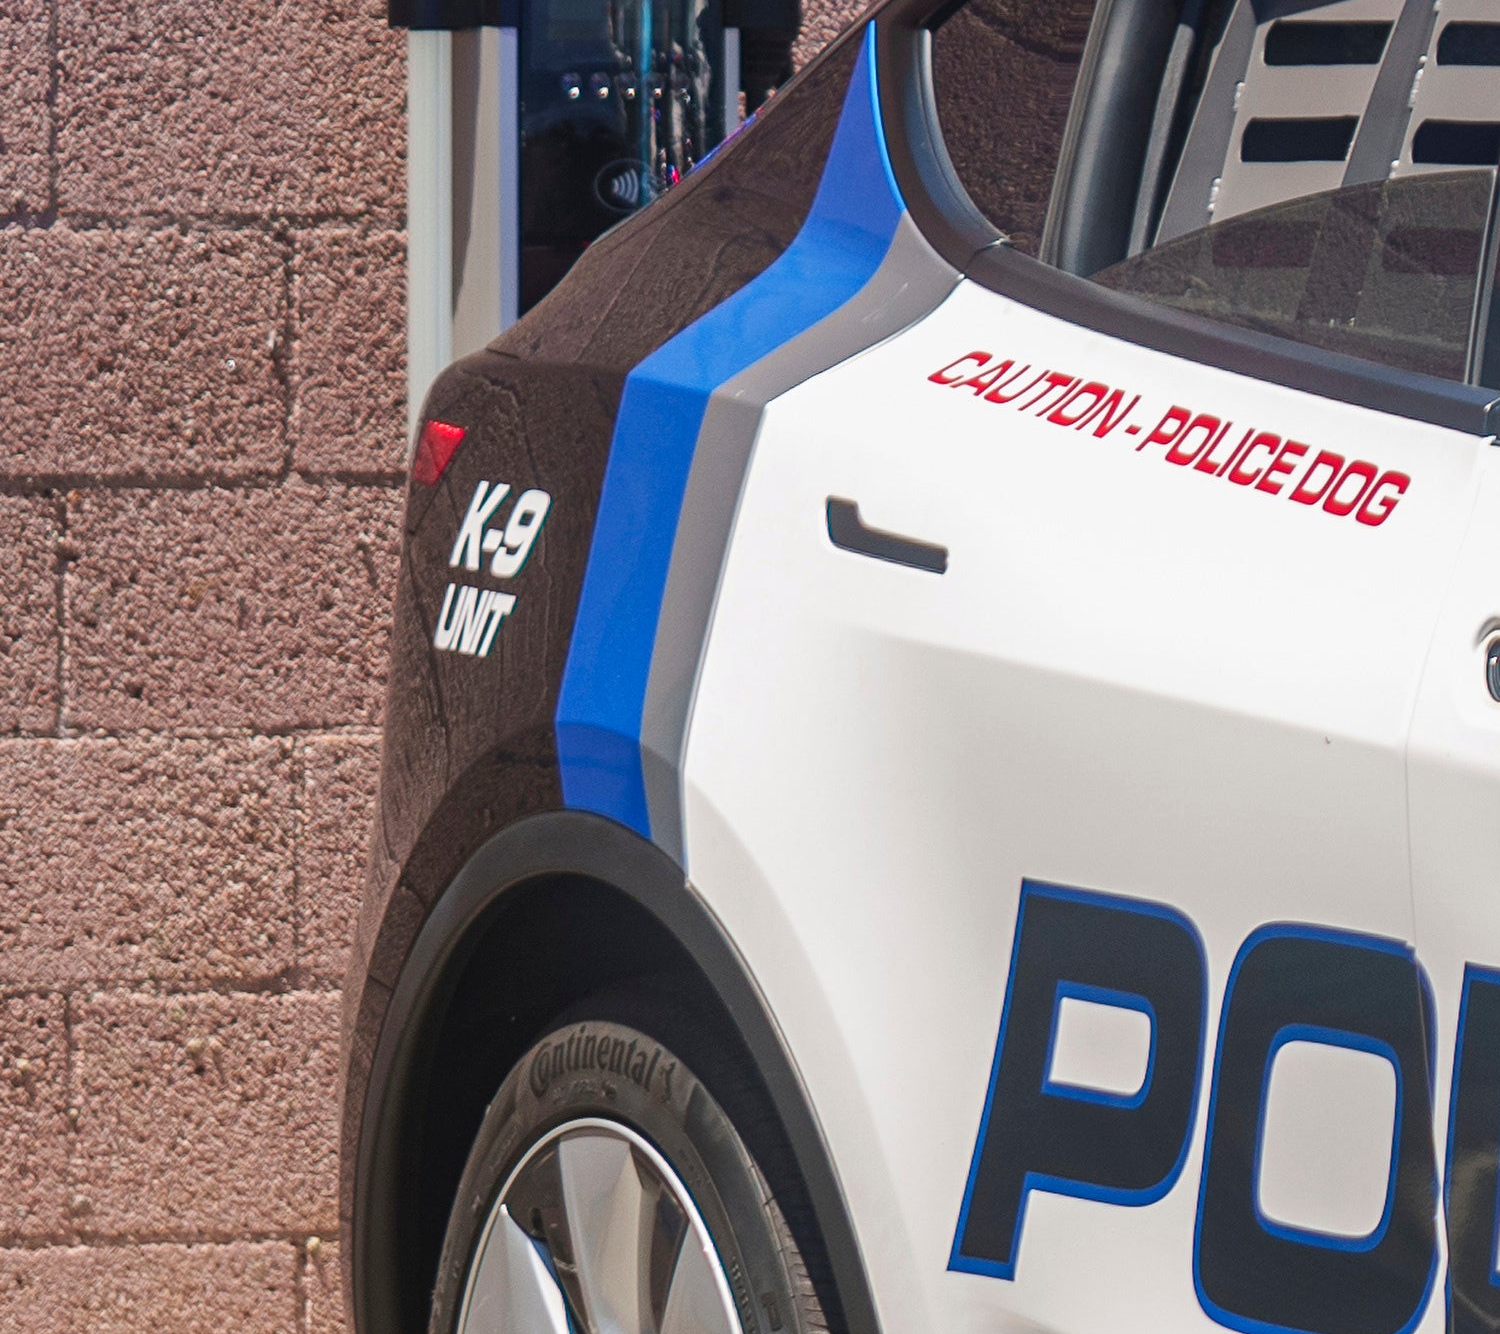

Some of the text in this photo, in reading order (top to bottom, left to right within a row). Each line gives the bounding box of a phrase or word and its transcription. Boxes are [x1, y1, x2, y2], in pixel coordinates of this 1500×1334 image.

[926, 349, 1136, 439] CAUTION
[1136, 404, 1312, 499] POLICE
[1288, 451, 1411, 529] DOG
[448, 479, 553, 580] K-9
[433, 582, 517, 659] UNIT
